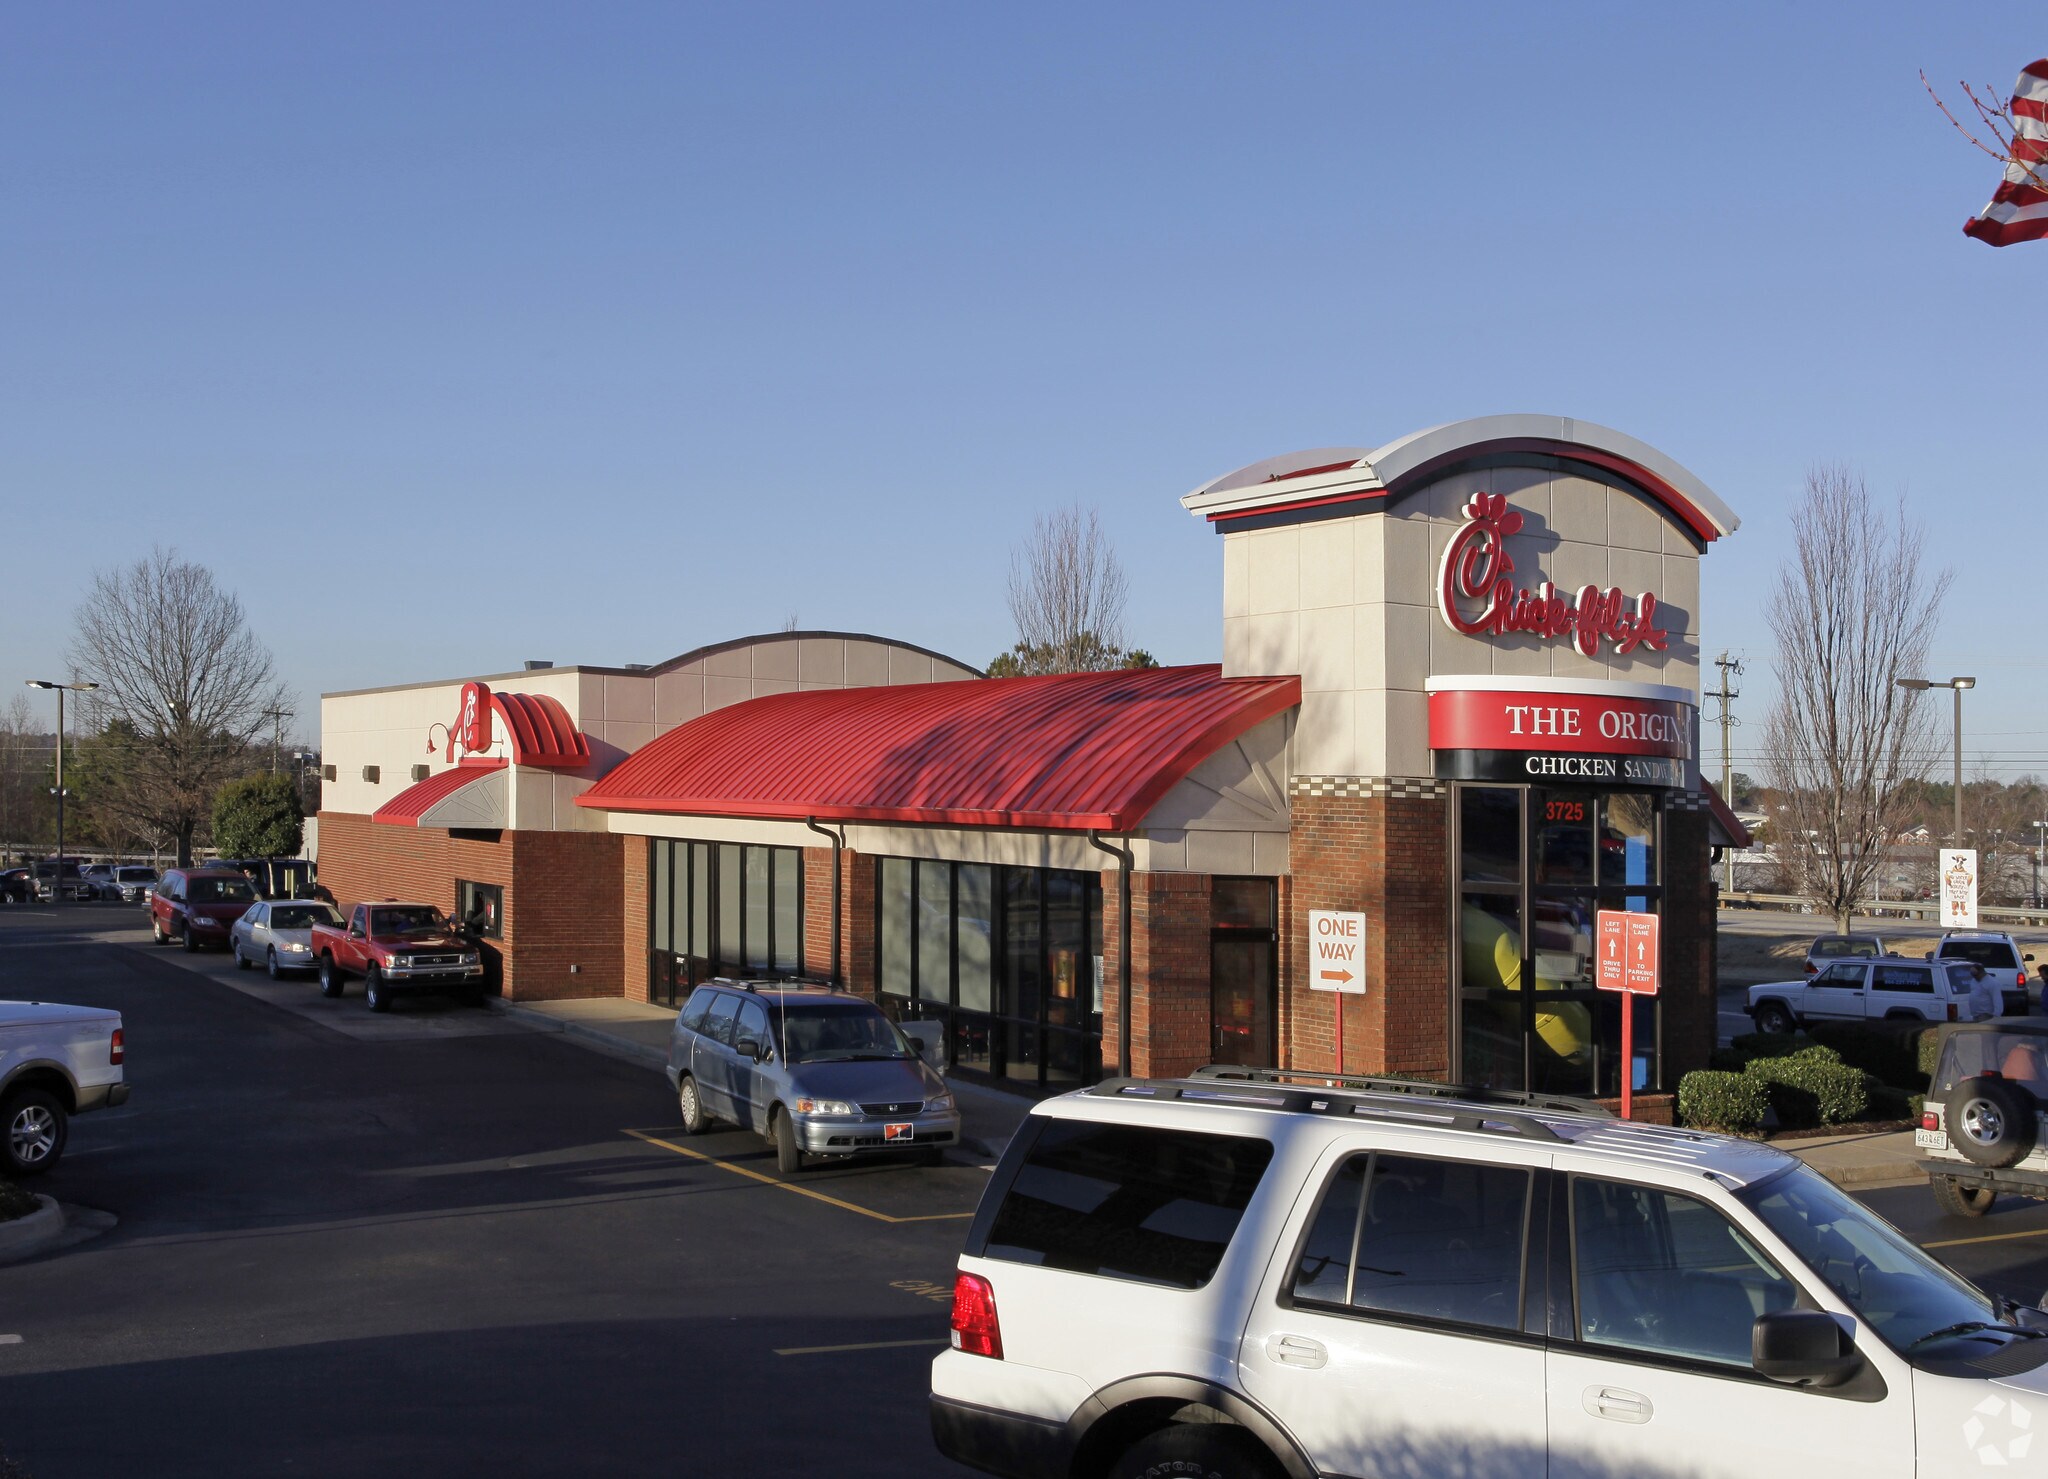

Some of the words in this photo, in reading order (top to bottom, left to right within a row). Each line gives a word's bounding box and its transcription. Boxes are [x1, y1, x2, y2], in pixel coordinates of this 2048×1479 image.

[1438, 492, 1668, 657] Chick-fil-A
[1505, 705, 1581, 736] THE
[1525, 756, 1617, 777] CHICKEN
[1546, 801, 1584, 821] 3725
[1317, 917, 1358, 937] ONE
[1317, 941, 1357, 961] WAY
[1627, 968, 1654, 976] PARKING
